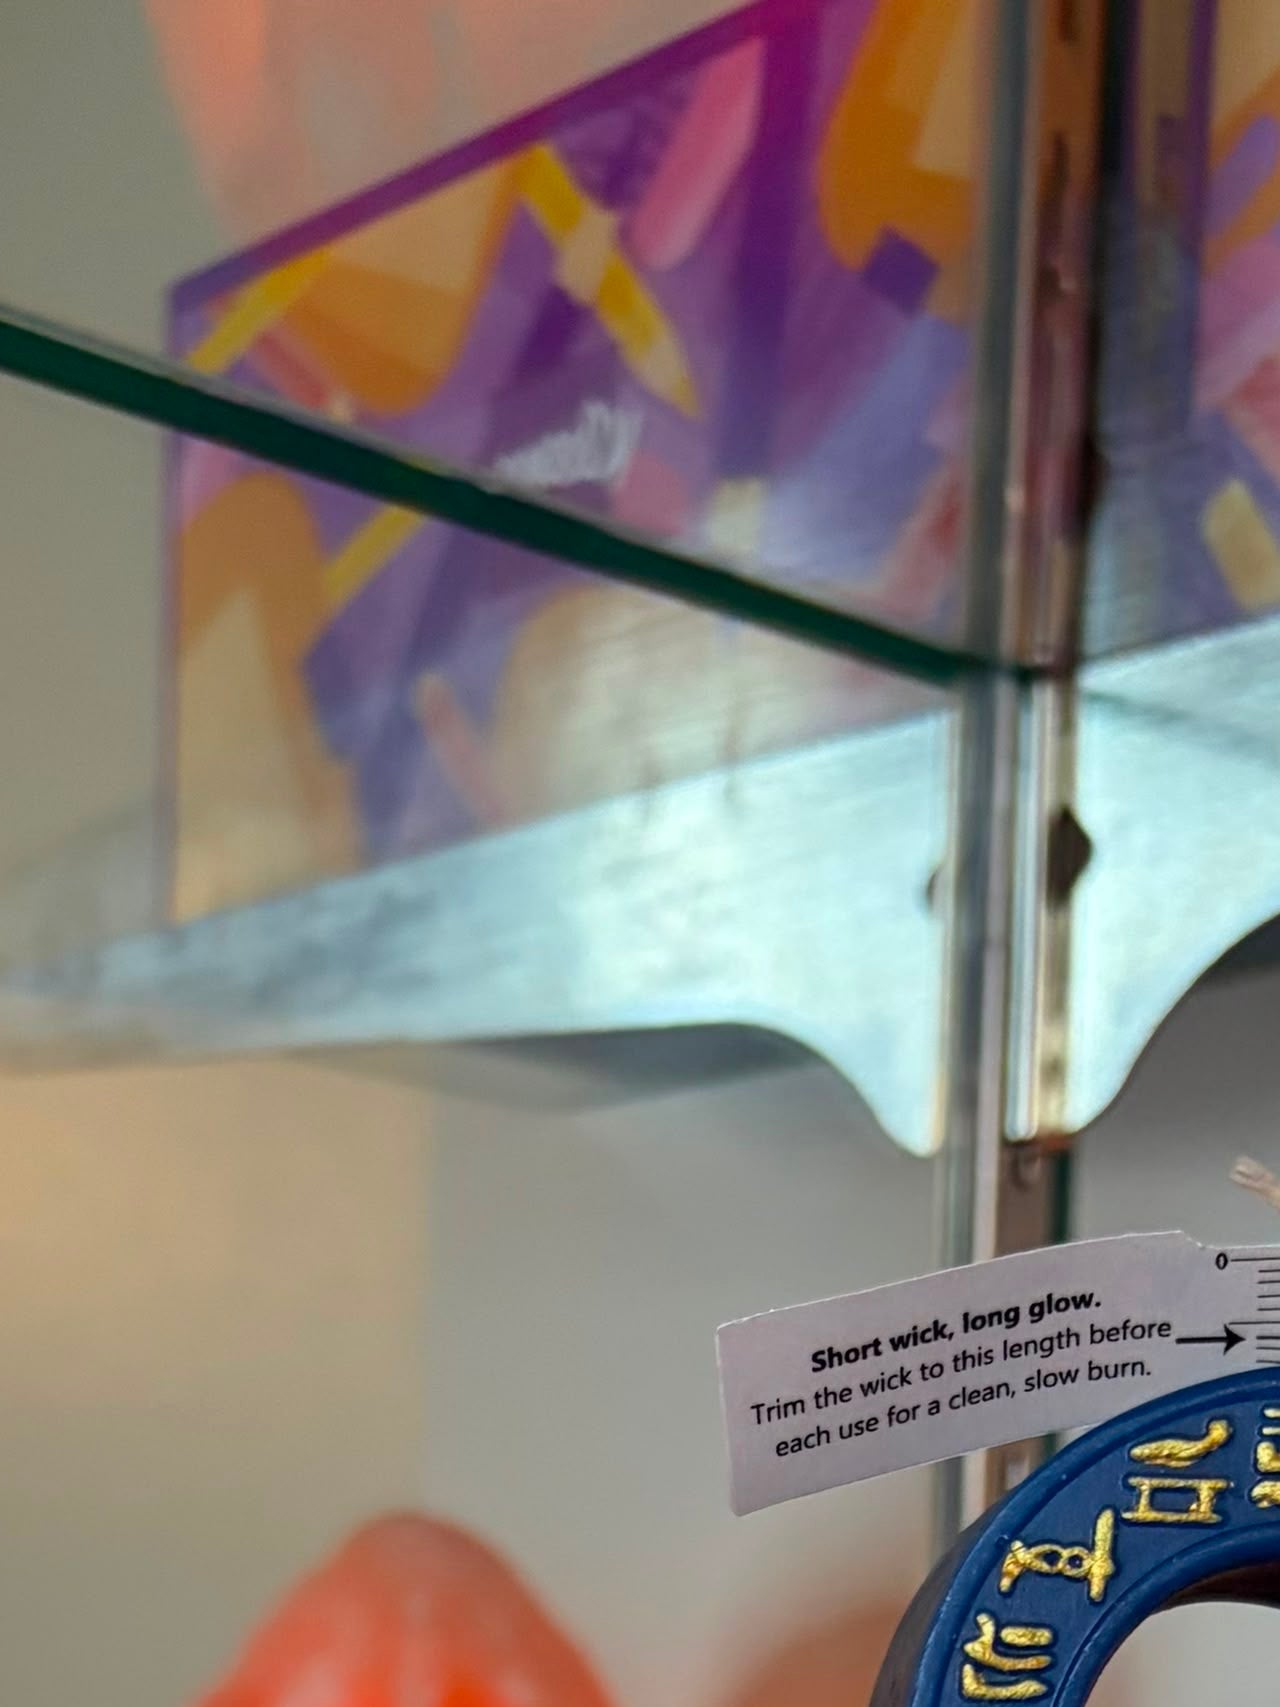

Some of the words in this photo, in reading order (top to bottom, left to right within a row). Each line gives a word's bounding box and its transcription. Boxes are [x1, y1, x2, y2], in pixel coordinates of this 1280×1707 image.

[1215, 1252, 1228, 1270] 0
[751, 1398, 805, 1424] Trim
[814, 1387, 852, 1409] the
[860, 1366, 912, 1397] wick
[920, 1362, 944, 1381] to
[952, 1346, 994, 1373] this
[1003, 1327, 1080, 1359] length
[1090, 1319, 1172, 1345] before
[811, 1337, 882, 1372] Short
[888, 1320, 954, 1351] wick,
[962, 1305, 1021, 1334] long
[1029, 1292, 1101, 1323] glow.
[775, 1426, 831, 1457] each
[839, 1416, 879, 1439] use
[887, 1404, 920, 1427] for
[927, 1400, 941, 1416] a
[948, 1381, 1016, 1411] clean,
[1024, 1369, 1079, 1393] slow
[1088, 1359, 1152, 1382] burn.
